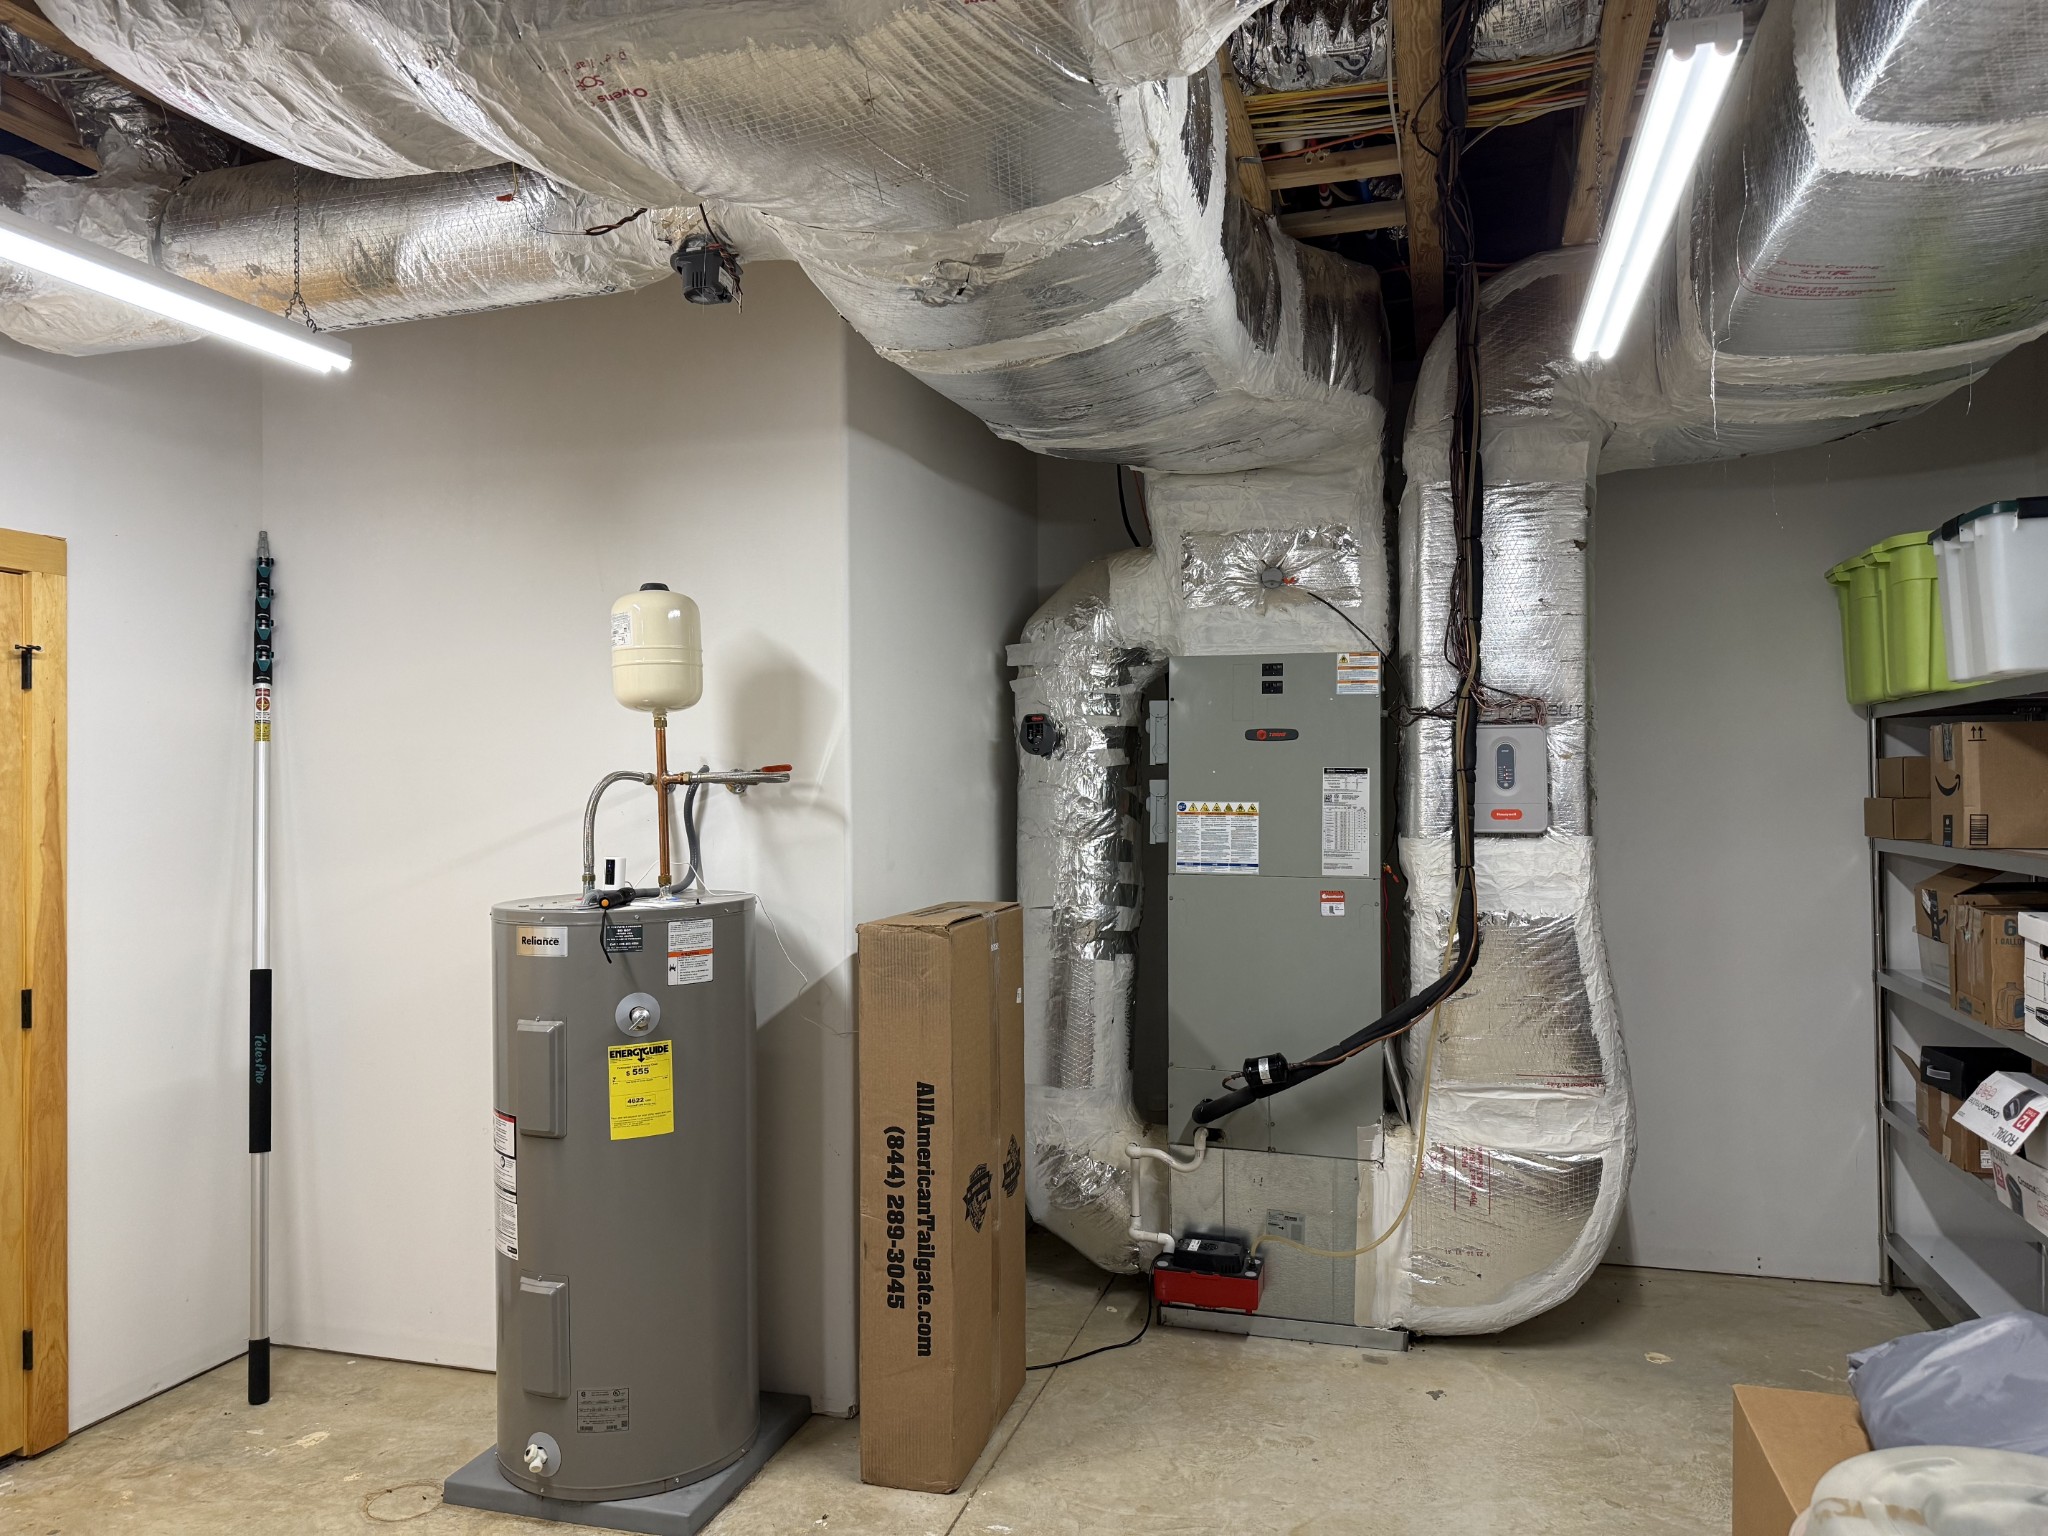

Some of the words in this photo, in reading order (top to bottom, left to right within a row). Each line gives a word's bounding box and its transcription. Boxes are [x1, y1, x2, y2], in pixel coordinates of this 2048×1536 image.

[597, 88, 648, 103] Owens
[1776, 260, 1821, 269] Owens
[2004, 918, 2017, 937] 6
[521, 936, 559, 946] Reliance
[2000, 938, 2025, 946] GALLO
[632, 1067, 650, 1076] 555
[2016, 1115, 2031, 1130] 12
[1994, 1126, 2020, 1147] ROYAL
[883, 1126, 906, 1188] (844)
[1469, 1191, 1478, 1207] Type
[913, 1081, 936, 1357] AllAmericanTailgate.com
[886, 1194, 906, 1310] 289-3045
